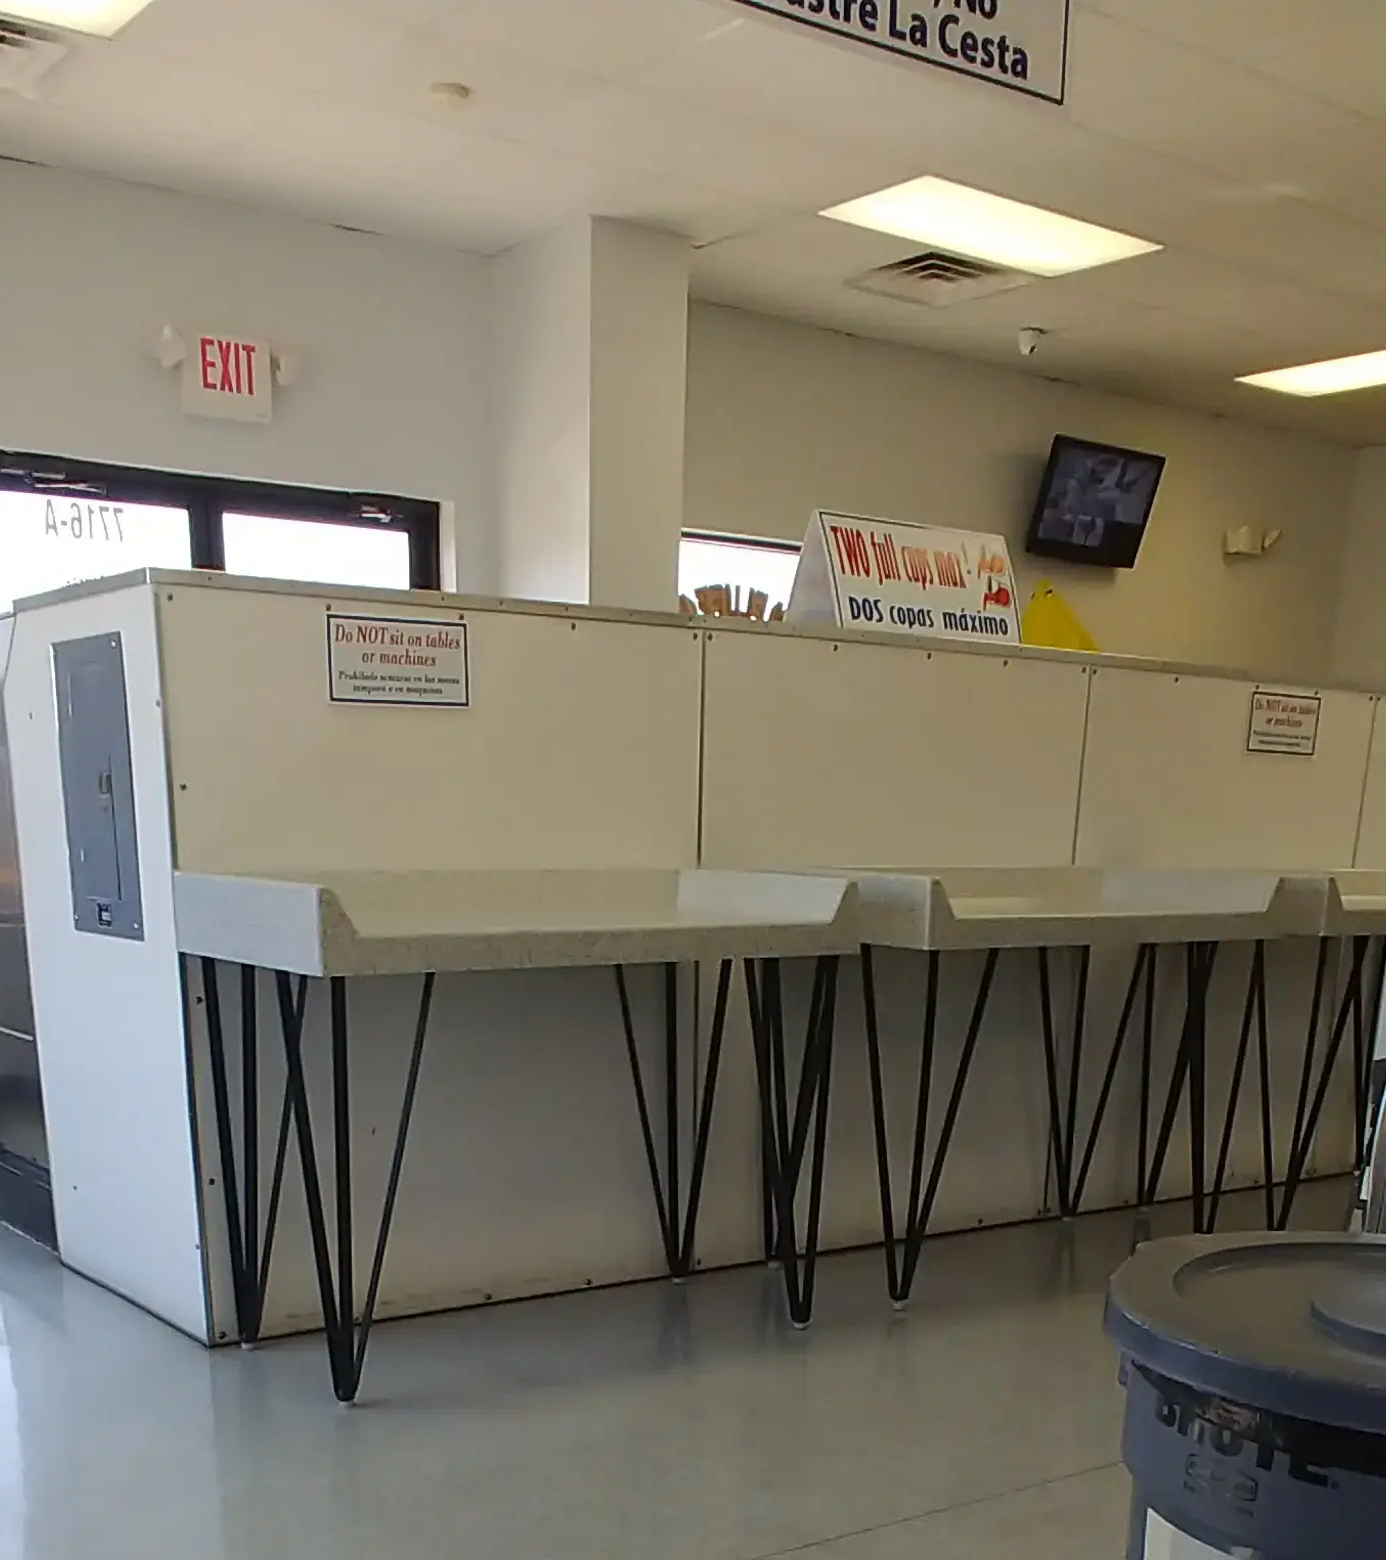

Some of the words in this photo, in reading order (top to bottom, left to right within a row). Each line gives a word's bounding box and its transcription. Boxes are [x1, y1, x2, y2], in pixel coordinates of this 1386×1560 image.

[888, 0, 929, 48] La
[938, 13, 1029, 80] Cesta
[199, 337, 257, 396] EXIT
[829, 525, 870, 578] TWO
[870, 529, 902, 586] full
[901, 545, 934, 590] cups
[334, 623, 354, 643] Do
[356, 624, 389, 645] NOT
[389, 629, 405, 646] sit
[407, 635, 423, 648] on
[425, 631, 461, 650] tables
[848, 595, 884, 624] DOS
[889, 606, 936, 629] copas
[942, 607, 1010, 636] máximo
[361, 651, 375, 664] or
[379, 648, 437, 668] machines
